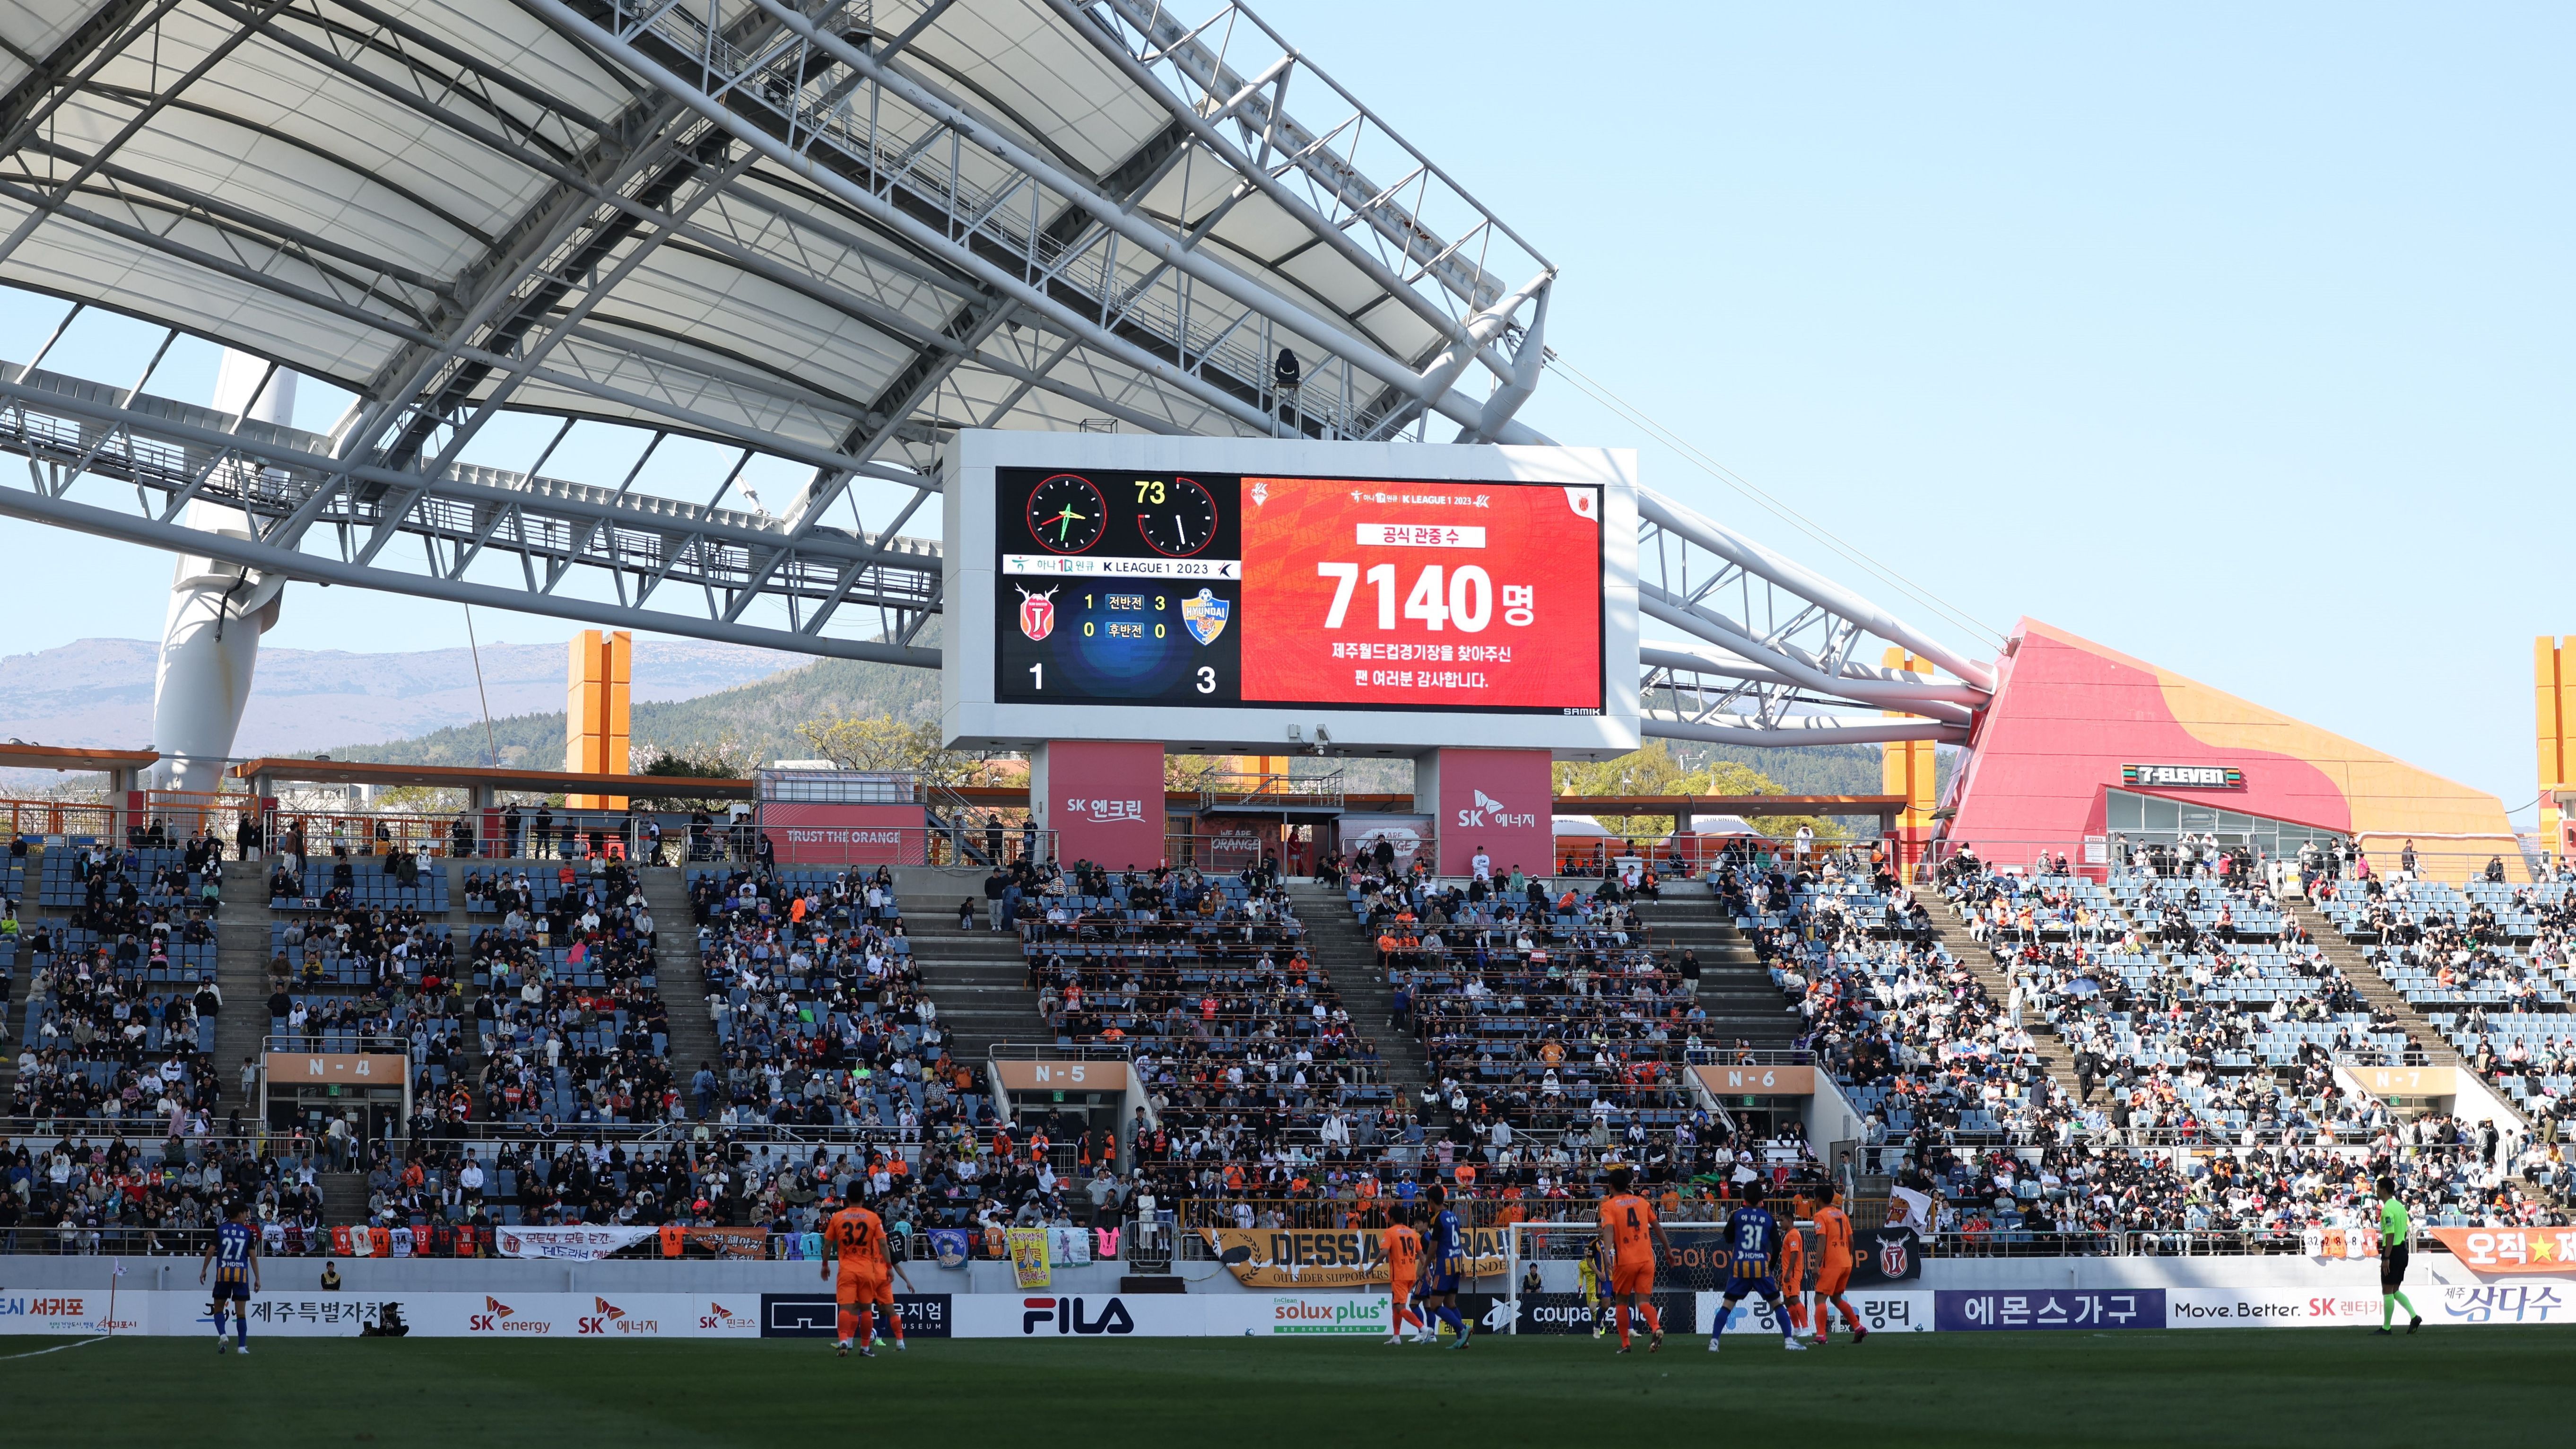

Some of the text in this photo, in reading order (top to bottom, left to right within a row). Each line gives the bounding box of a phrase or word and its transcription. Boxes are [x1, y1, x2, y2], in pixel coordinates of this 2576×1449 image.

[1135, 481, 1166, 504] 73
[1402, 495, 1410, 503] K
[1411, 495, 1445, 505] LEAGUE
[1447, 496, 1451, 504] 1
[1454, 497, 1471, 505] 2023
[1384, 527, 1459, 544] 공식 관중 수
[1104, 562, 1113, 571] K
[1116, 562, 1163, 573] LEAGUE
[1165, 564, 1170, 573] 1
[1177, 564, 1209, 574] 2023
[1085, 594, 1092, 609] 1
[1108, 596, 1142, 611] 전반전
[1155, 596, 1166, 611] 3
[1317, 562, 1534, 633] 7140 명
[1186, 607, 1225, 619] HYUNDAI
[1084, 622, 1094, 637] 0
[1108, 624, 1142, 639] 후반전
[1155, 624, 1166, 639] 0
[1332, 642, 1511, 663] 제주월드컵경기장을 찾아주신
[1029, 663, 1042, 690] 1
[1196, 666, 1216, 694] 3
[1355, 670, 1489, 689] 팬 여러분 감사합니다.
[1067, 799, 1142, 819] SK 엔크린
[1458, 809, 1535, 828] SK 에너지
[786, 830, 901, 844] TRUST THE ORANGE
[1212, 838, 1259, 851] ORANGE
[1364, 840, 1412, 852] ORNGE
[1627, 1207, 1640, 1227] 4
[340, 1234, 347, 1245] 9
[357, 1233, 364, 1244] 9
[373, 1235, 384, 1247] 14
[396, 1235, 407, 1245] 14
[416, 1231, 426, 1241] 13
[438, 1231, 449, 1242] 13
[479, 1231, 492, 1243] 35
[565, 1232, 584, 1244] 모든
[670, 1231, 676, 1241] 6
[842, 1222, 868, 1247] 32
[991, 1234, 998, 1244] 17
[1452, 1224, 1460, 1247] 6
[1741, 1224, 1763, 1251] 31
[2307, 1236, 2318, 1246] 32
[2352, 1236, 2357, 1246] 8
[222, 1237, 246, 1260] 27
[890, 1239, 902, 1253] 12
[1399, 1236, 1414, 1257] 19
[2466, 1231, 2527, 1265] 오직
[1273, 1269, 1389, 1283] OUTSIDER SUPPORTERS
[29, 1298, 84, 1316] 서귀포
[1275, 1300, 1333, 1319] solux
[1964, 1296, 2137, 1325] 에몬스가구
[2175, 1298, 2384, 1318] Move. Better. SK 렌터카
[2444, 1286, 2562, 1322] 제주 삼다수
[1023, 1297, 1134, 1335] FILA
[1533, 1306, 1617, 1327] coupag
[1864, 1300, 1909, 1329] 링티
[470, 1314, 550, 1334] SK energy
[578, 1317, 658, 1334] SK 에너지
[699, 1316, 756, 1329] SK 핀크스
[1831, 1321, 1851, 1332] fex
